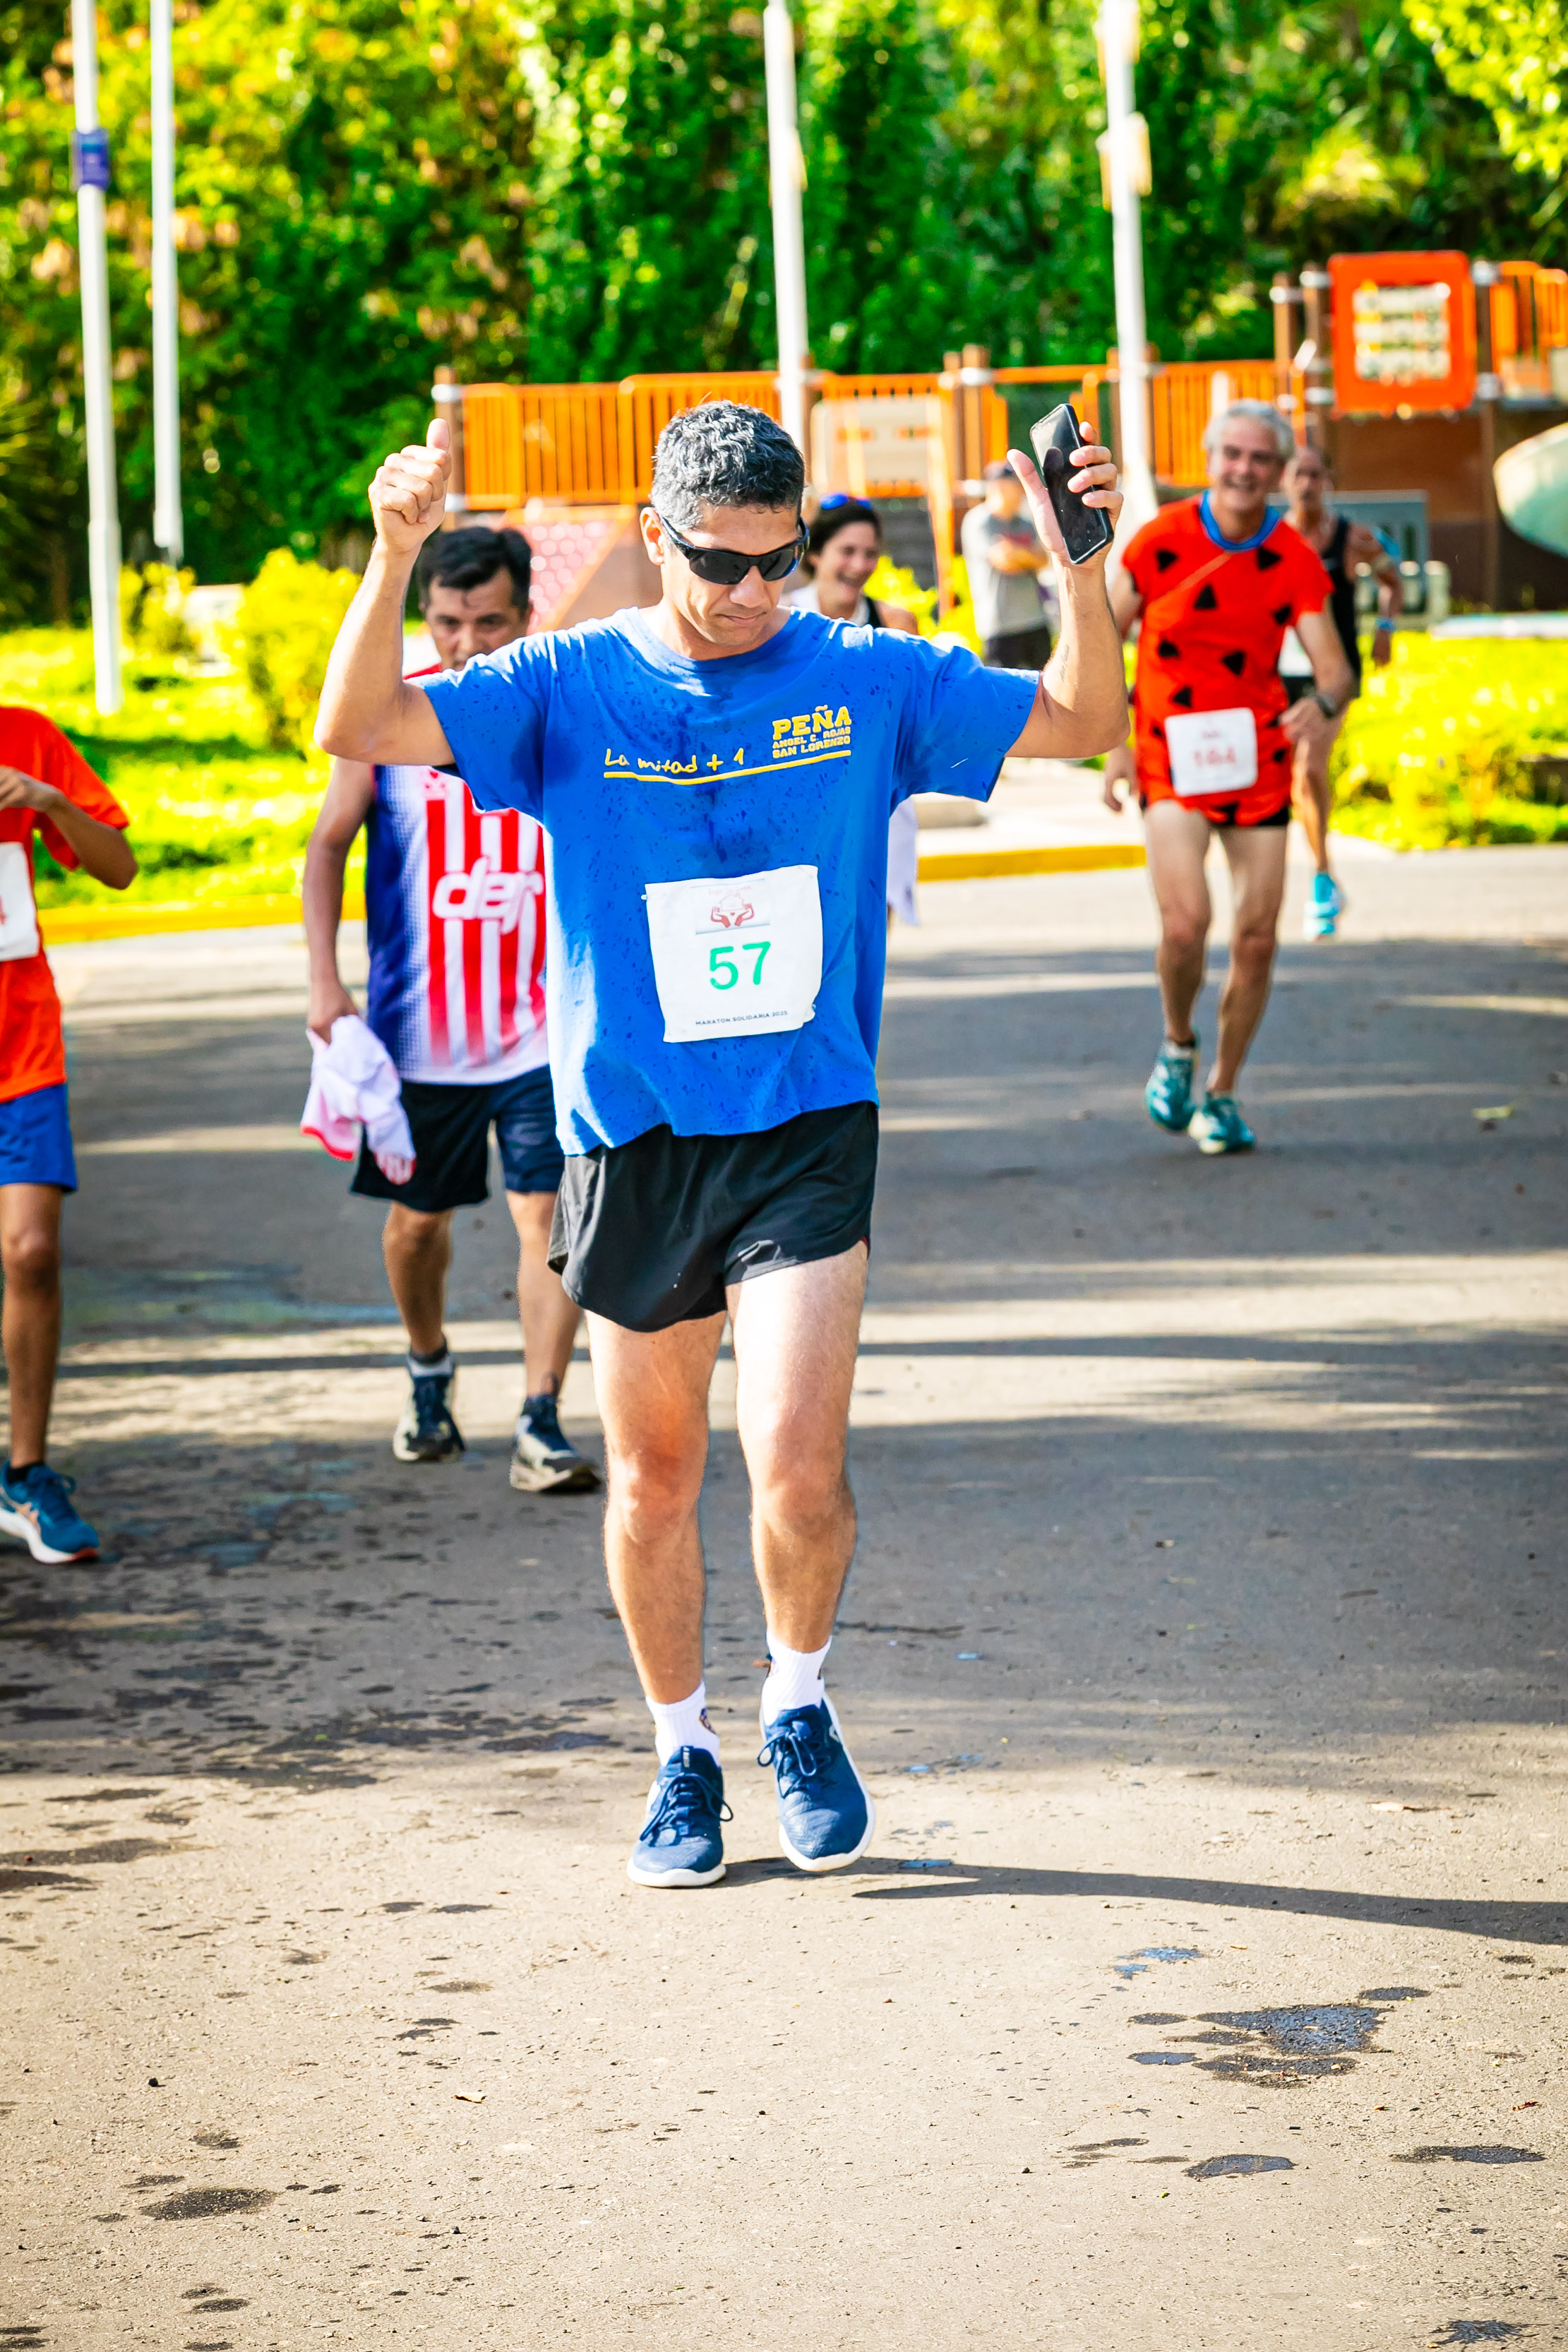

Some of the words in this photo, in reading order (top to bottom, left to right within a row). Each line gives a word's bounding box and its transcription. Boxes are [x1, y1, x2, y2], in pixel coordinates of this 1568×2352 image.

[772, 705, 852, 741] PEÑA
[772, 736, 807, 749] ANGEL
[822, 727, 851, 739] ROJAS
[772, 746, 797, 759] SAN
[801, 735, 851, 753] LORENZO
[604, 748, 630, 766] La
[638, 754, 698, 774] mitad
[706, 753, 724, 771] +
[734, 747, 744, 765] 1
[710, 941, 771, 990] 57
[733, 1013, 770, 1022] SOLIDARIA
